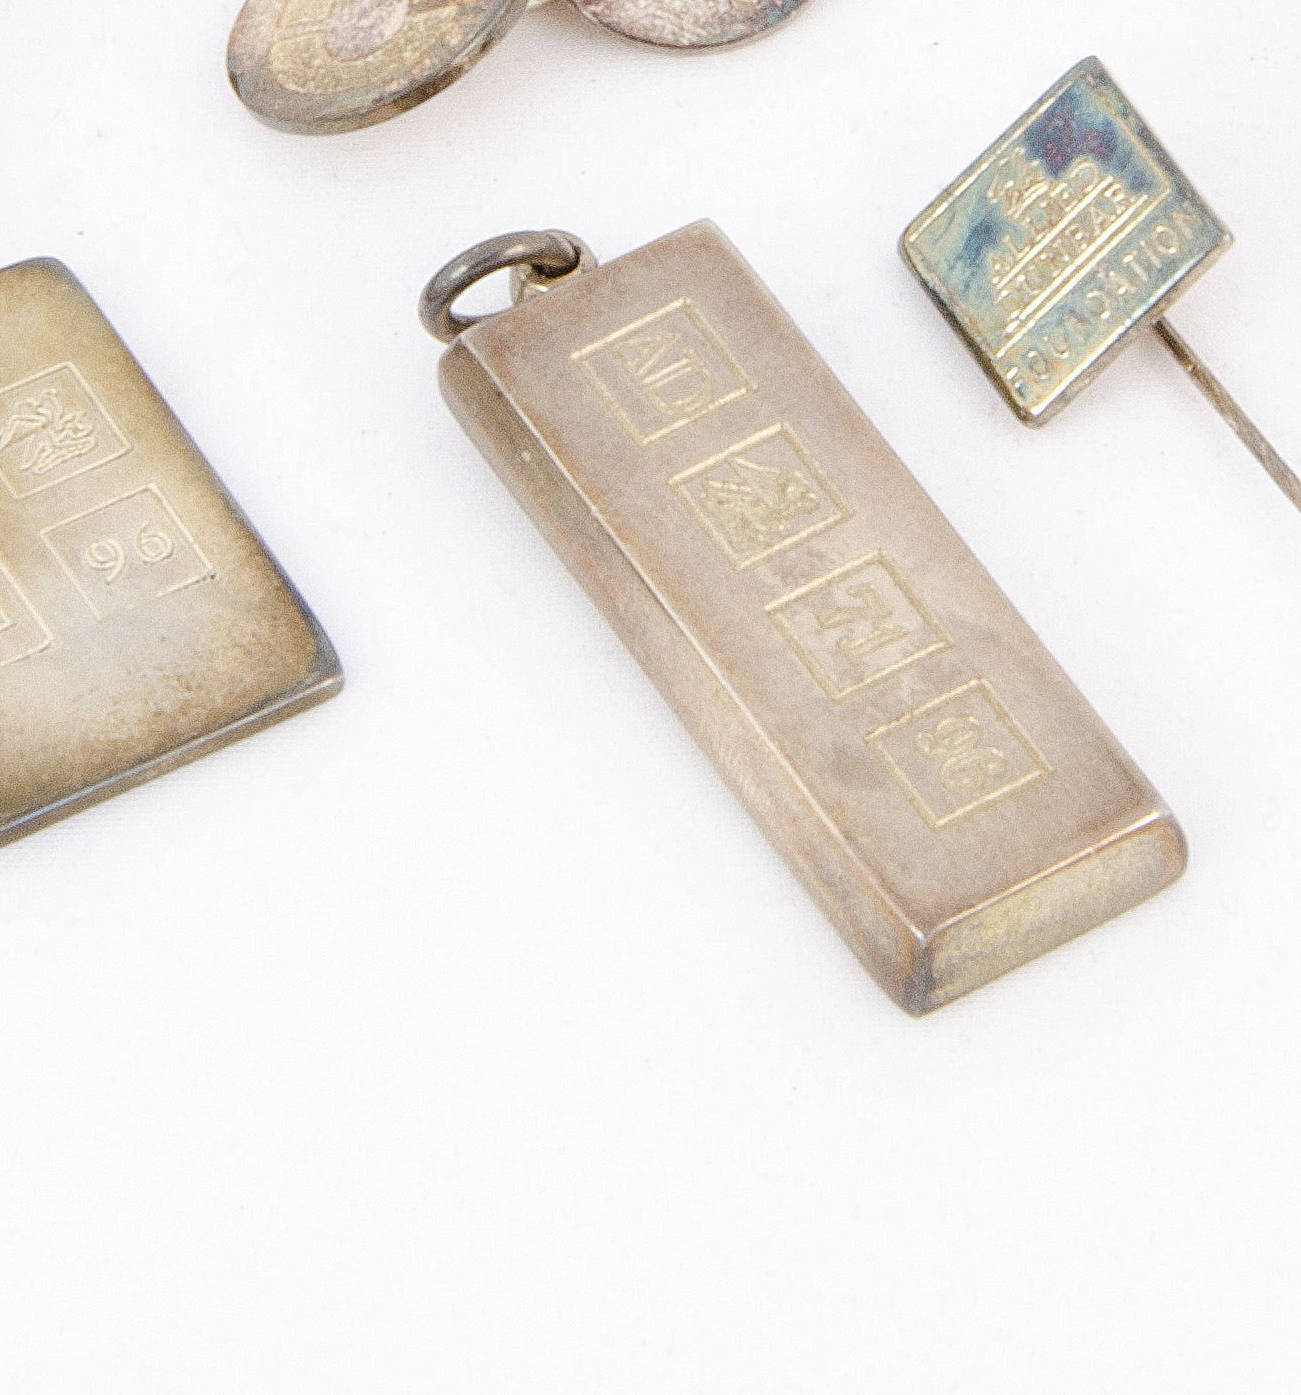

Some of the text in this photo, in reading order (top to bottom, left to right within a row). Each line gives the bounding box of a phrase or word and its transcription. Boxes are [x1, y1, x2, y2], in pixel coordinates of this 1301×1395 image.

[1004, 202, 1205, 400] FOUNDATION
[612, 328, 722, 417] AD
[85, 522, 175, 584] 96
[812, 582, 912, 669] 71
[912, 713, 1010, 794] 96
